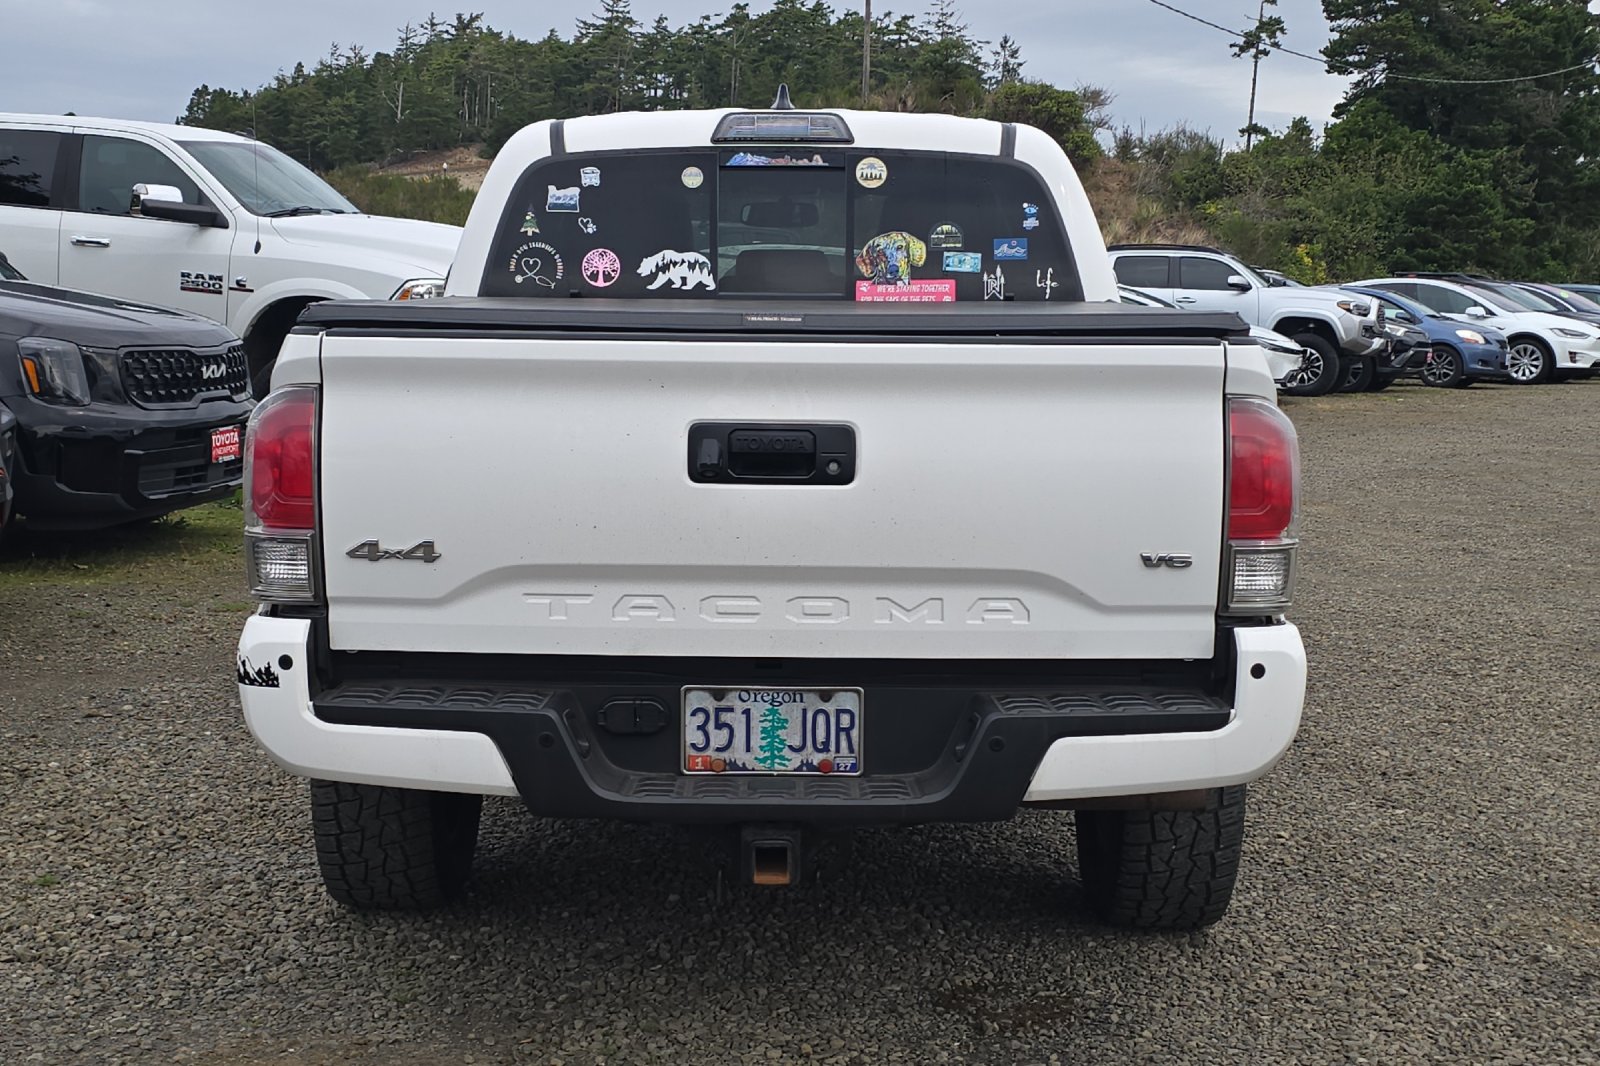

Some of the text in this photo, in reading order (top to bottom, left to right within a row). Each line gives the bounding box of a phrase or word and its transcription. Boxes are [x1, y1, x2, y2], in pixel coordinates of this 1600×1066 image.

[180, 270, 223, 282] RAM
[180, 279, 223, 290] 2500
[896, 284, 920, 293] STAYING
[921, 284, 950, 293] TOGETHER
[201, 363, 226, 379] KIA
[212, 432, 239, 447] TOYOTA
[735, 436, 809, 449] TOYOTA
[1139, 551, 1194, 569] V6
[521, 592, 1031, 625] TACOMA
[738, 690, 805, 707] Oregon
[689, 707, 856, 754] 351 JQR
[694, 757, 705, 769] 1
[838, 763, 852, 771] 27
